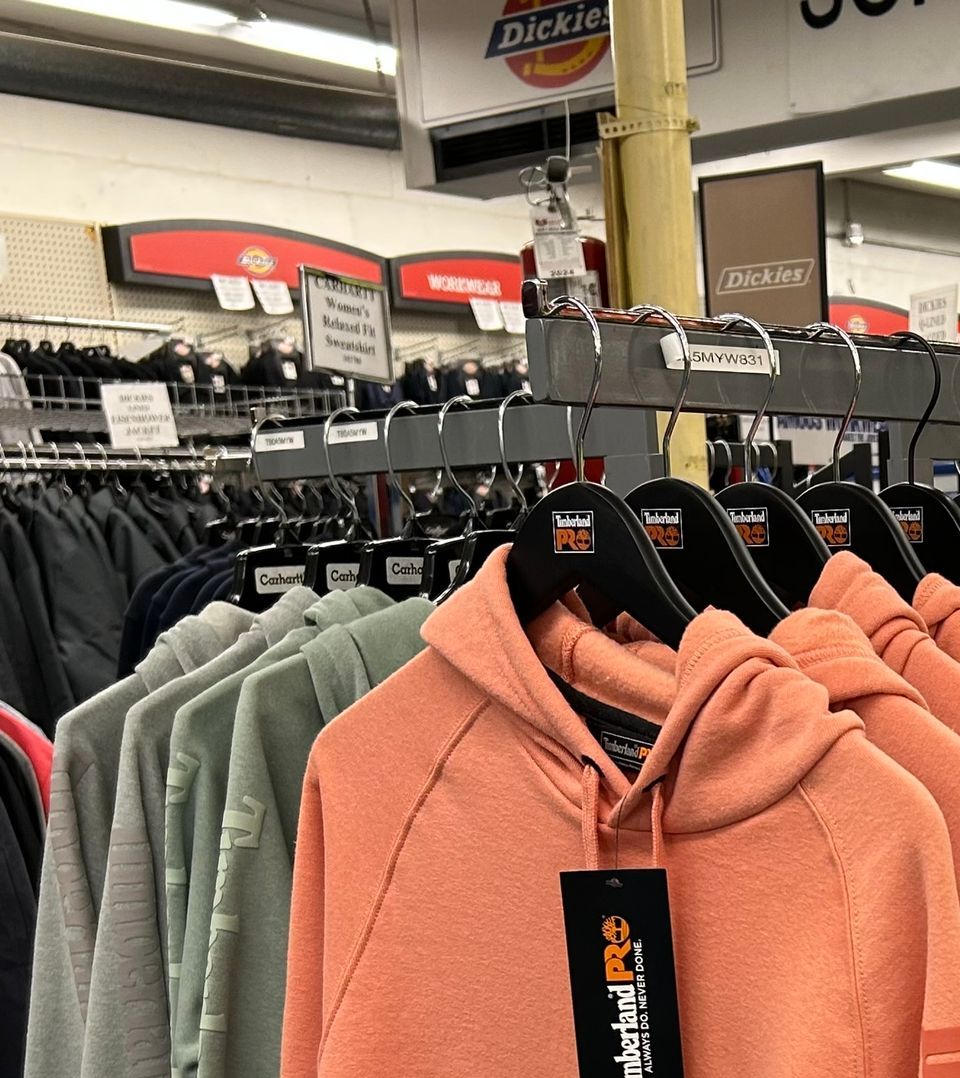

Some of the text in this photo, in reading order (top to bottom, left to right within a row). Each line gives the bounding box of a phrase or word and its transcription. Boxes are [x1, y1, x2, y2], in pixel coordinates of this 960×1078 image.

[724, 265, 805, 289] Dickies
[427, 273, 502, 296] WORKWEAR
[689, 351, 763, 366] 5MYW831
[555, 515, 591, 527] Timberland
[644, 512, 680, 524] Timberland
[729, 510, 765, 523] Timberland
[814, 512, 848, 524] Timberland
[632, 938, 654, 1073] ALWAYS DO. NEVER DONE.
